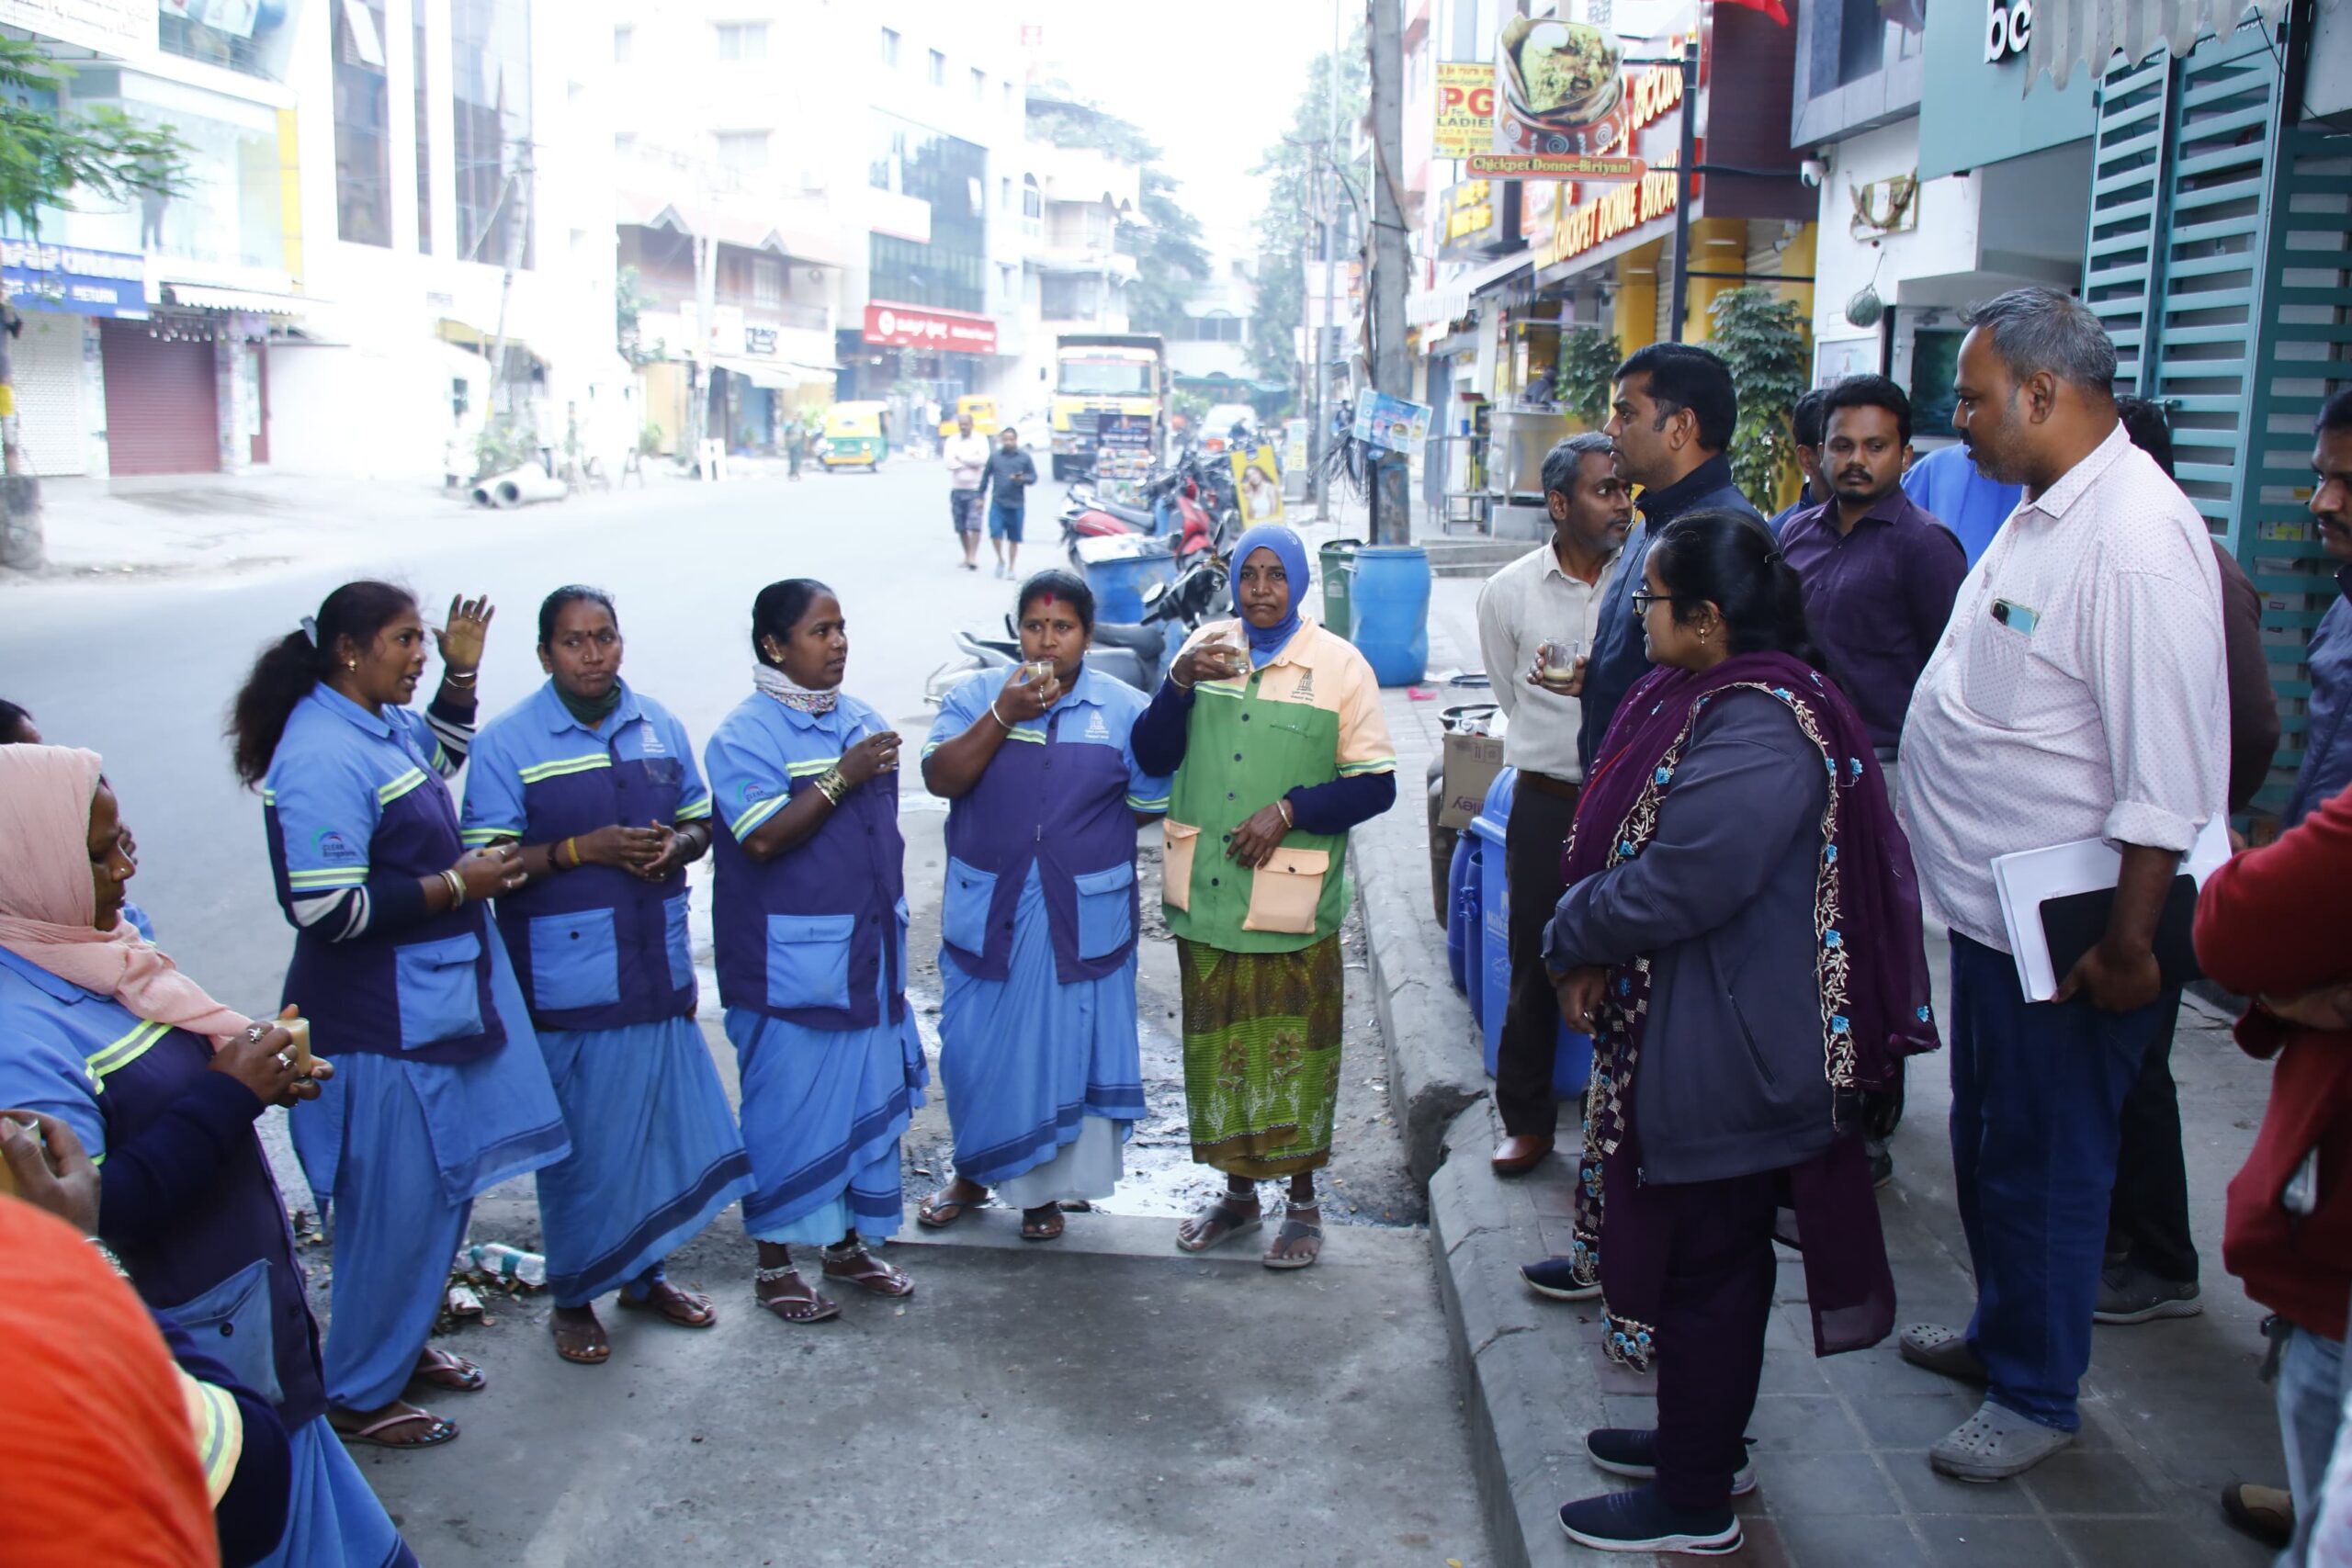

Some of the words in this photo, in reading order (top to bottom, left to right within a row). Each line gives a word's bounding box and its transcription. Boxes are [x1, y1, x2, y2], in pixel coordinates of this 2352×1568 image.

[1984, 0, 2030, 64] bc
[1439, 87, 1494, 118] PG
[1473, 157, 1530, 174] Chickpet
[1555, 197, 1598, 264] CHICKPET
[1599, 181, 1637, 243] DONNE
[1640, 148, 1679, 222] BIRYA
